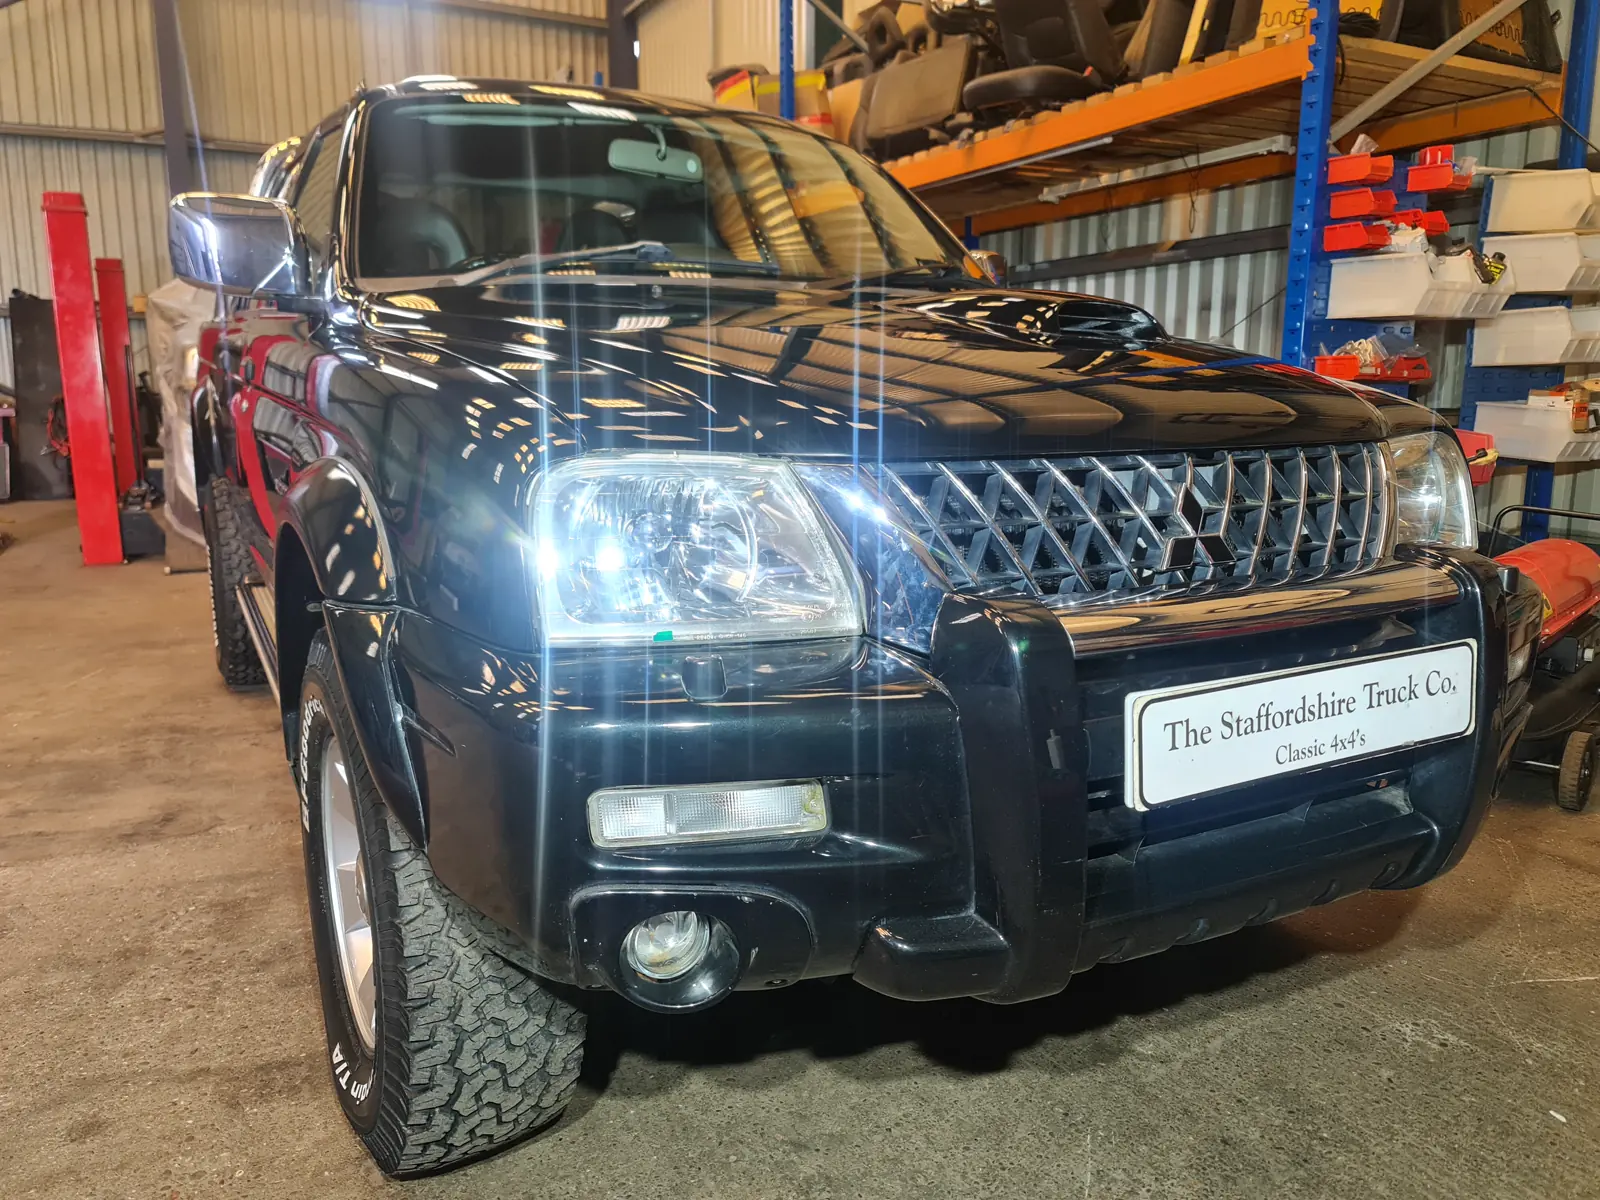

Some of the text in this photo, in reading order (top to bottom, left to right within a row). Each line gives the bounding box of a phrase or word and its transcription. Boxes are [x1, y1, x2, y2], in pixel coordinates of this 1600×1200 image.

[1163, 670, 1457, 752] The Staffordshire Truck Co.
[1275, 728, 1366, 765] Classic 4x4's
